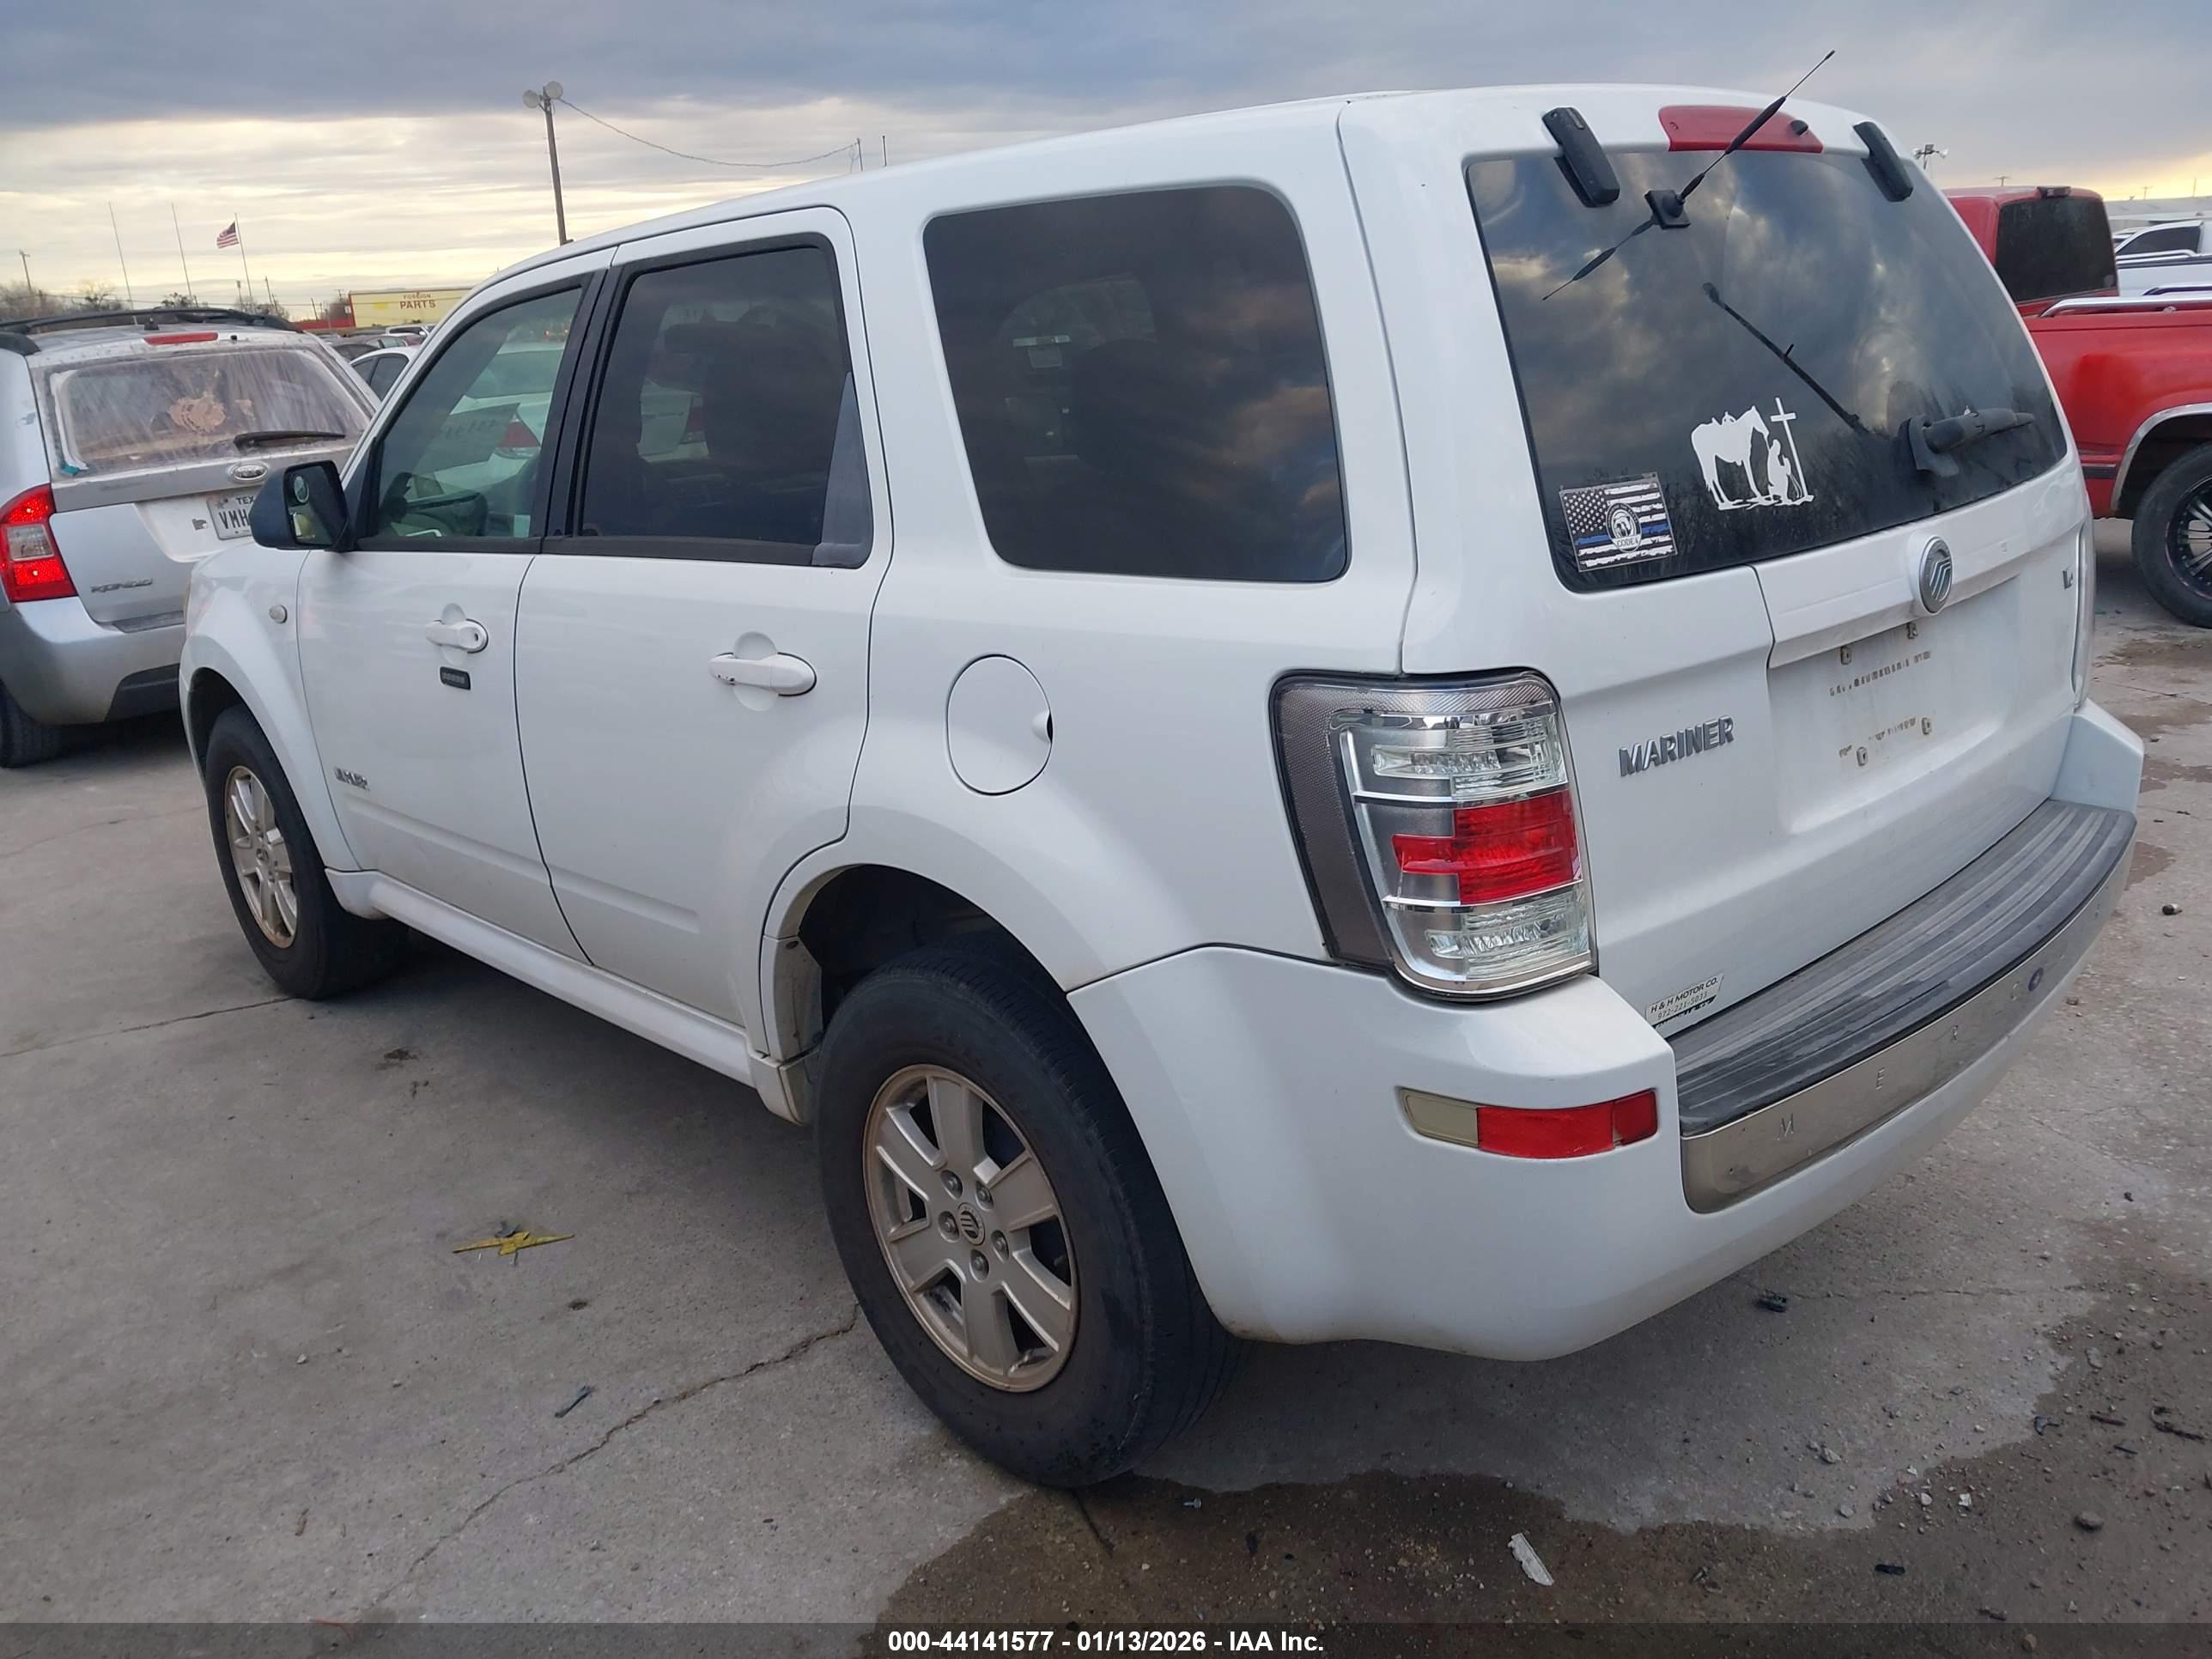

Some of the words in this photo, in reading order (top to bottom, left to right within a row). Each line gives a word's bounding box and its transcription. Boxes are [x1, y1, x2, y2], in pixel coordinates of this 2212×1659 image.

[399, 300, 436, 310] PARTS
[235, 495, 255, 505] TEX
[218, 508, 251, 530] VMH
[1619, 714, 1735, 777] MARINER
[1650, 1004, 1658, 1013] H
[1658, 1001, 1666, 1010] &
[1667, 998, 1674, 1006] H
[1674, 983, 1705, 1003] MOTOR
[1705, 977, 1718, 988] CO.
